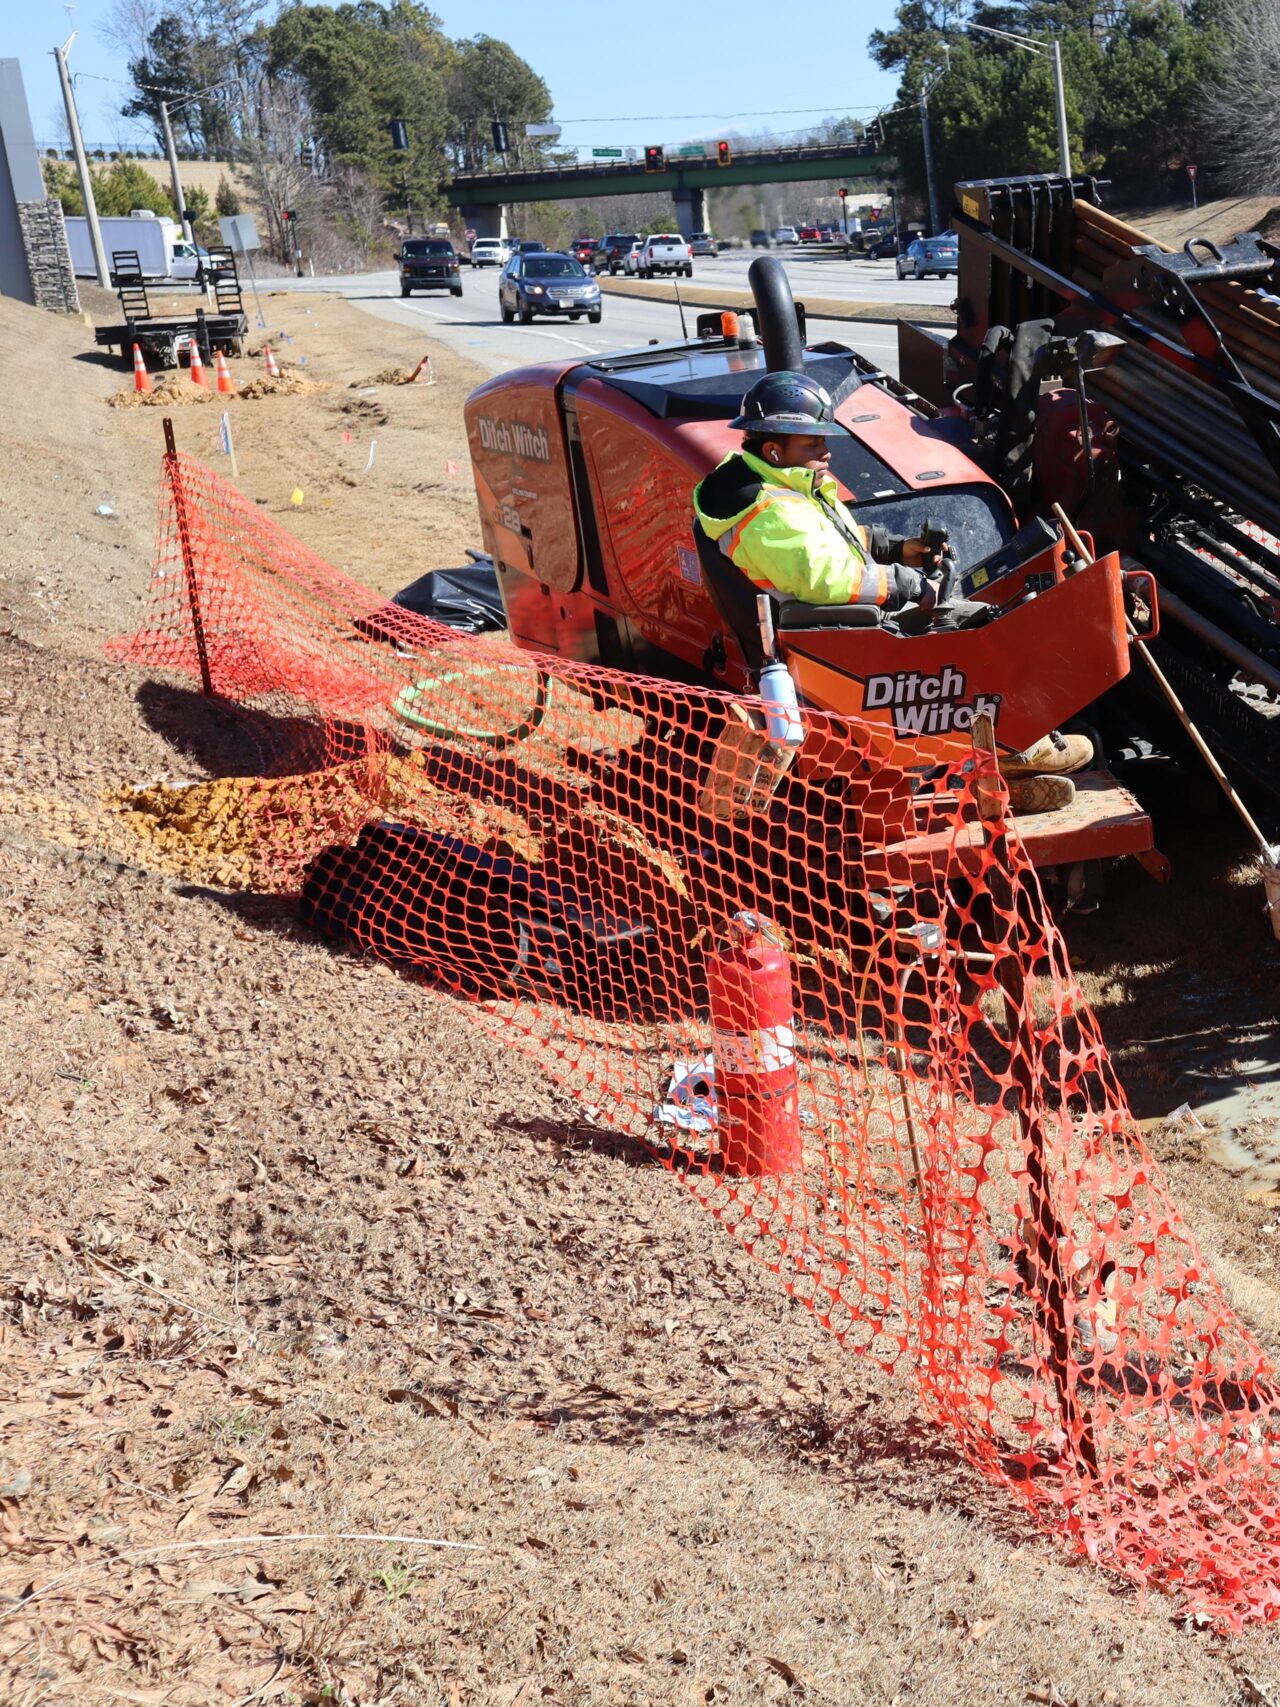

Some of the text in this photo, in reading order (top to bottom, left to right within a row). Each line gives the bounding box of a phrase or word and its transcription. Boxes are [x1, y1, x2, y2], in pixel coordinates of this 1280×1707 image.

[478, 418, 549, 460] Ditch Witch
[866, 668, 964, 707] Ditch
[895, 698, 997, 736] Witch
